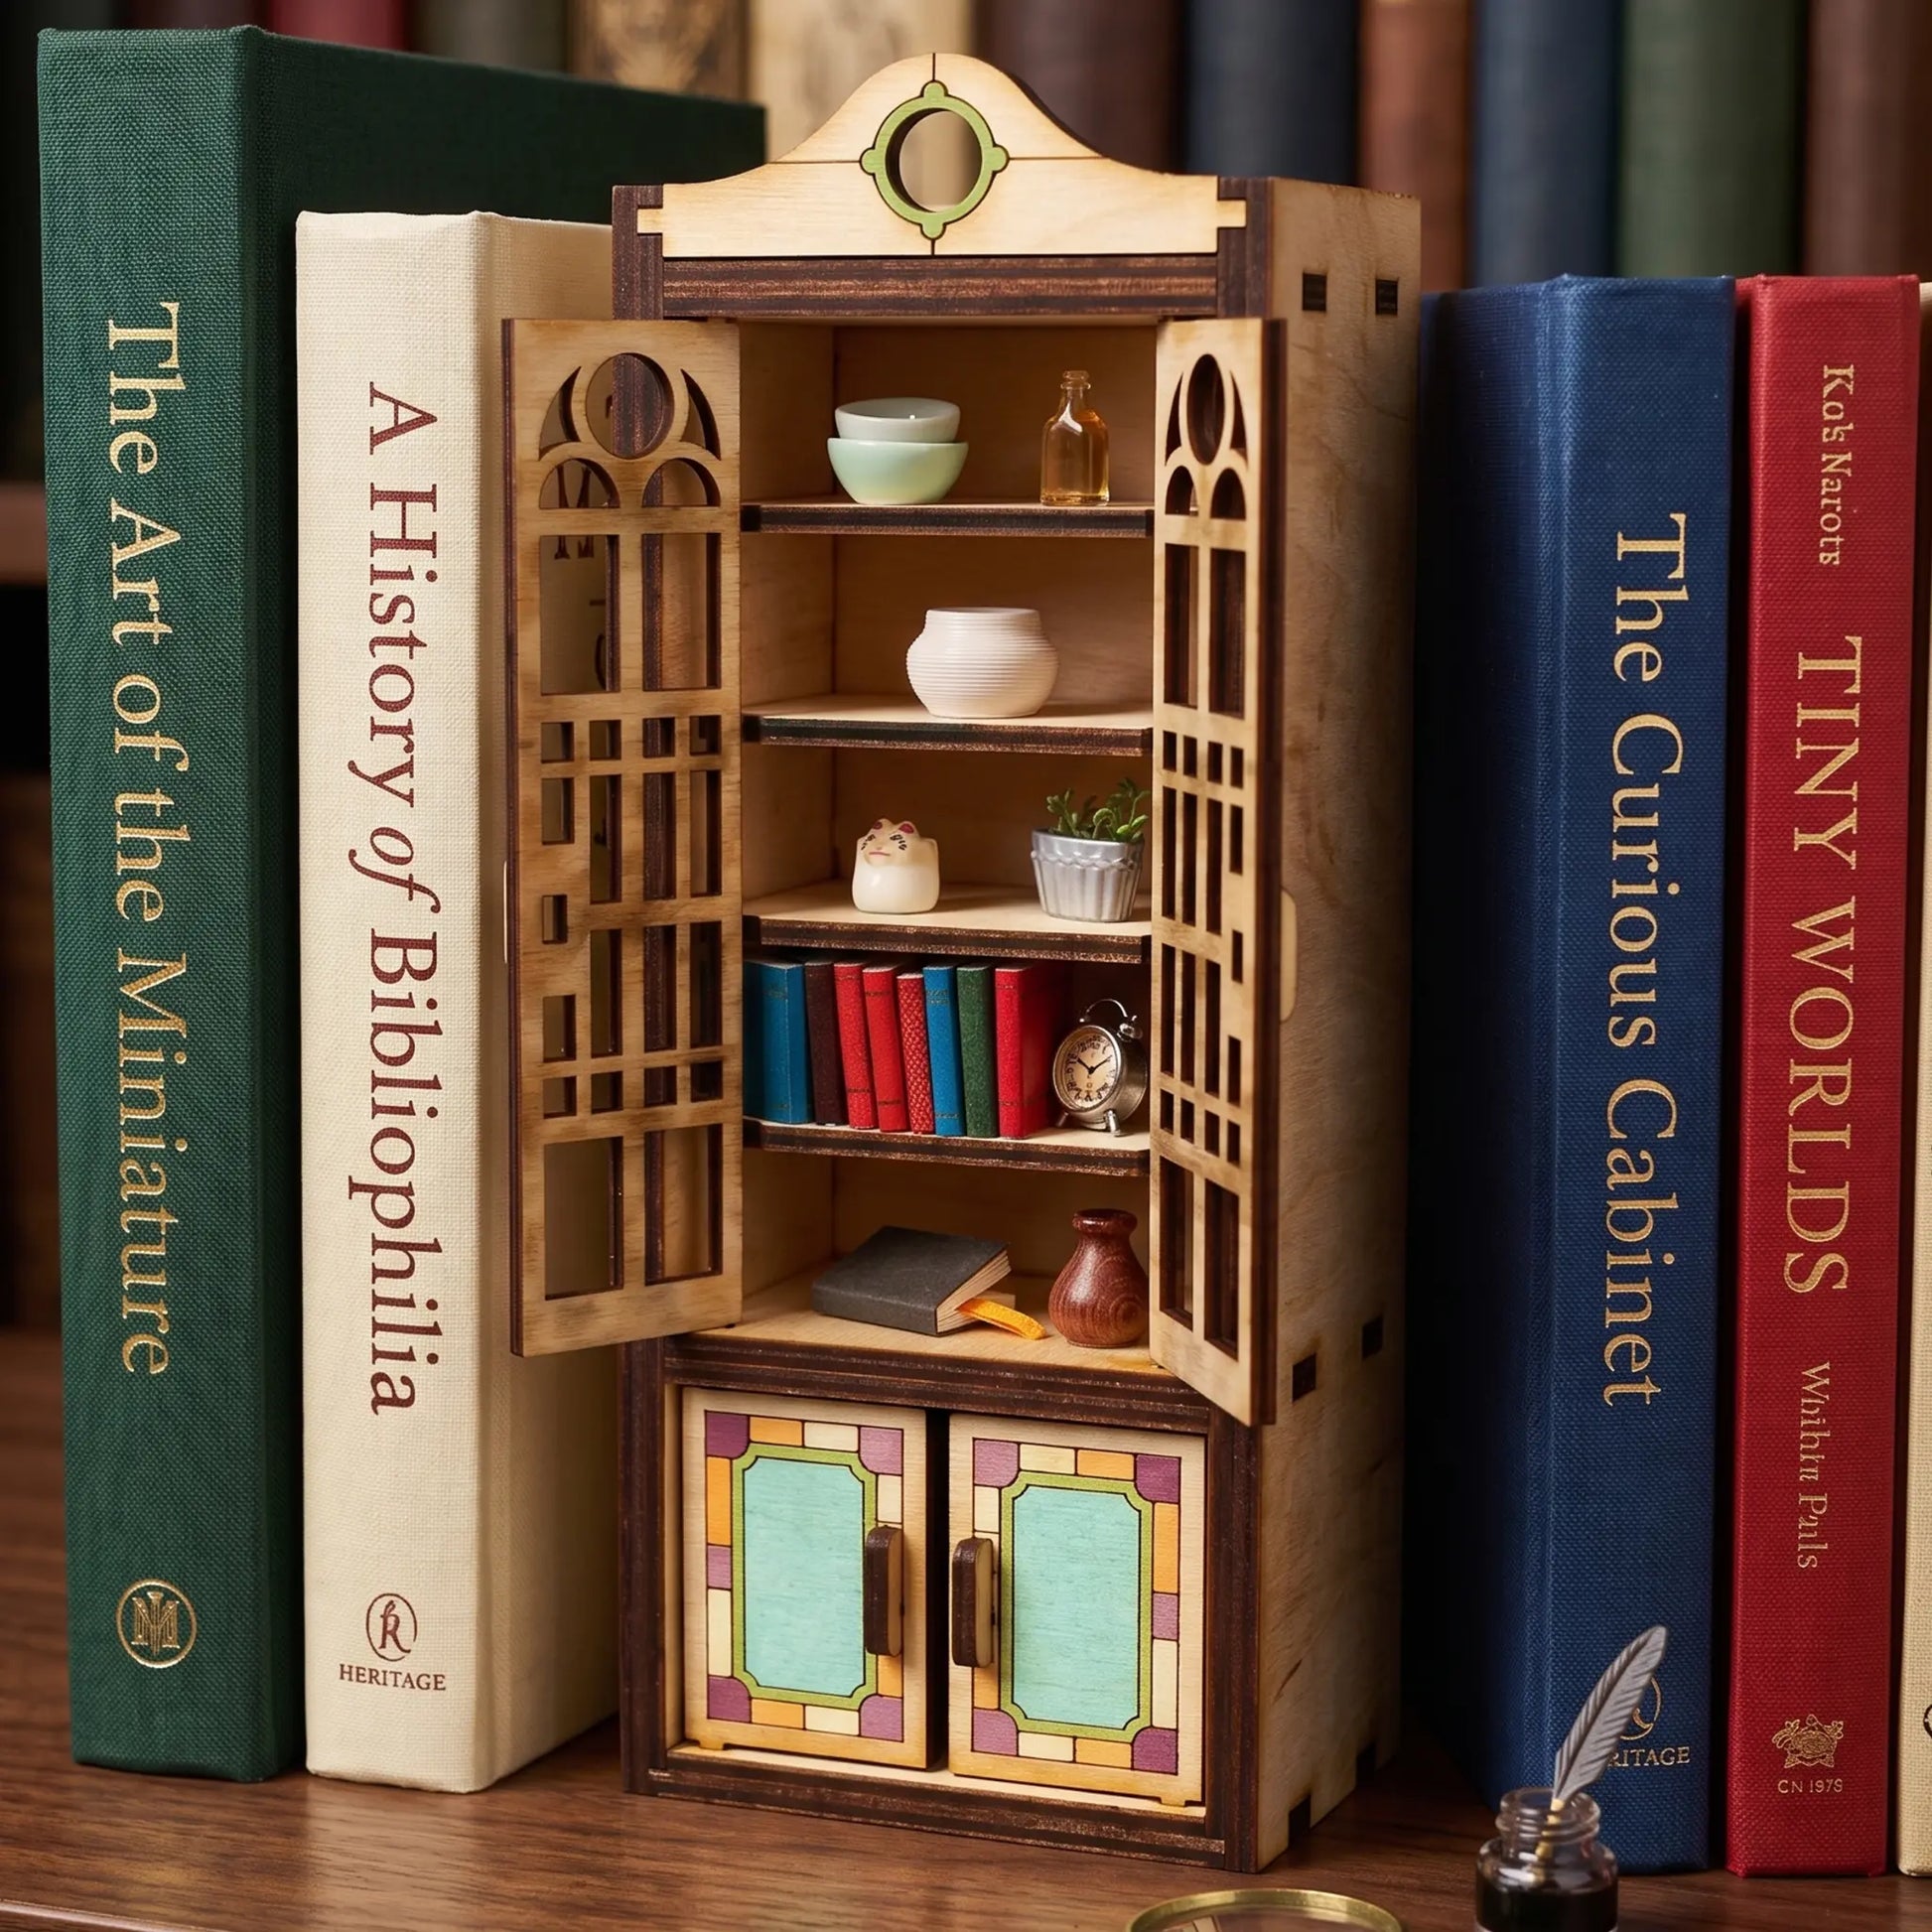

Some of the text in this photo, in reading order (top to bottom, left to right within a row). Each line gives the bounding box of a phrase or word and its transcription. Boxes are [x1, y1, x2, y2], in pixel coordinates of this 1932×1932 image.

[106, 300, 192, 1375] The Art of the Miniature
[347, 381, 443, 1415] A History of Bibliophilia
[1603, 512, 1690, 1406] The Curious Cabinet
[1783, 634, 1863, 1294] TINY WORLDS
[339, 1663, 447, 1692] HERITAGE
[1607, 1745, 1691, 1767] RITAGE
[1777, 1779, 1803, 1794] CN
